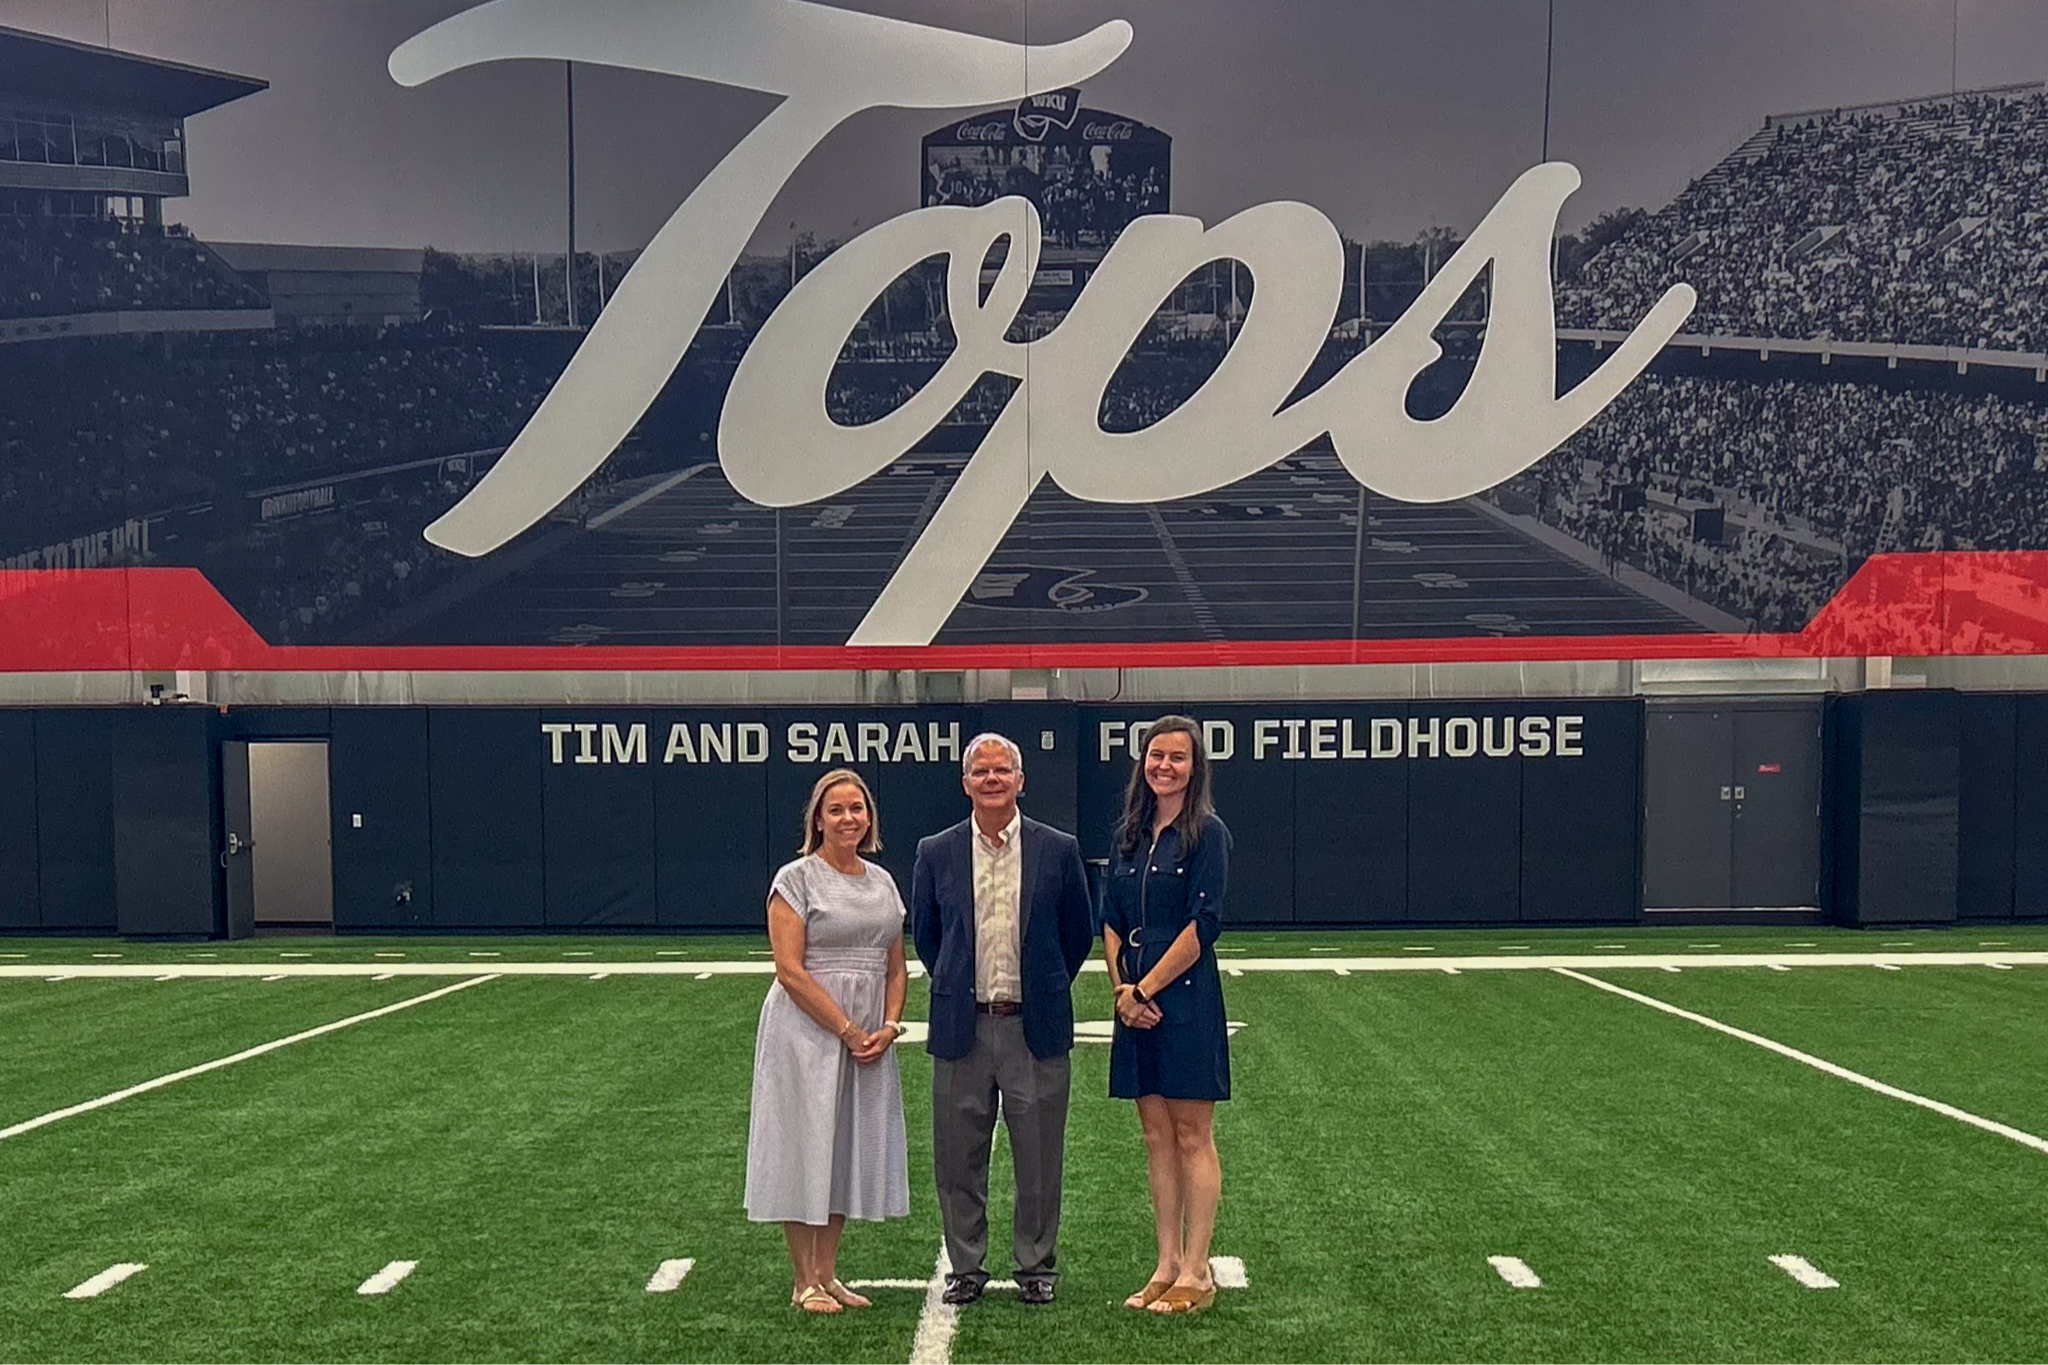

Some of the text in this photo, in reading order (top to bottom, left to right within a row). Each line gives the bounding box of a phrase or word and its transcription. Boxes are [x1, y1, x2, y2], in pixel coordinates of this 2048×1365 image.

[1031, 93, 1067, 111] WKU
[389, 0, 1697, 647] Tops
[542, 716, 1583, 763] TIM AND SARAH FOD FIELDHOUSE
